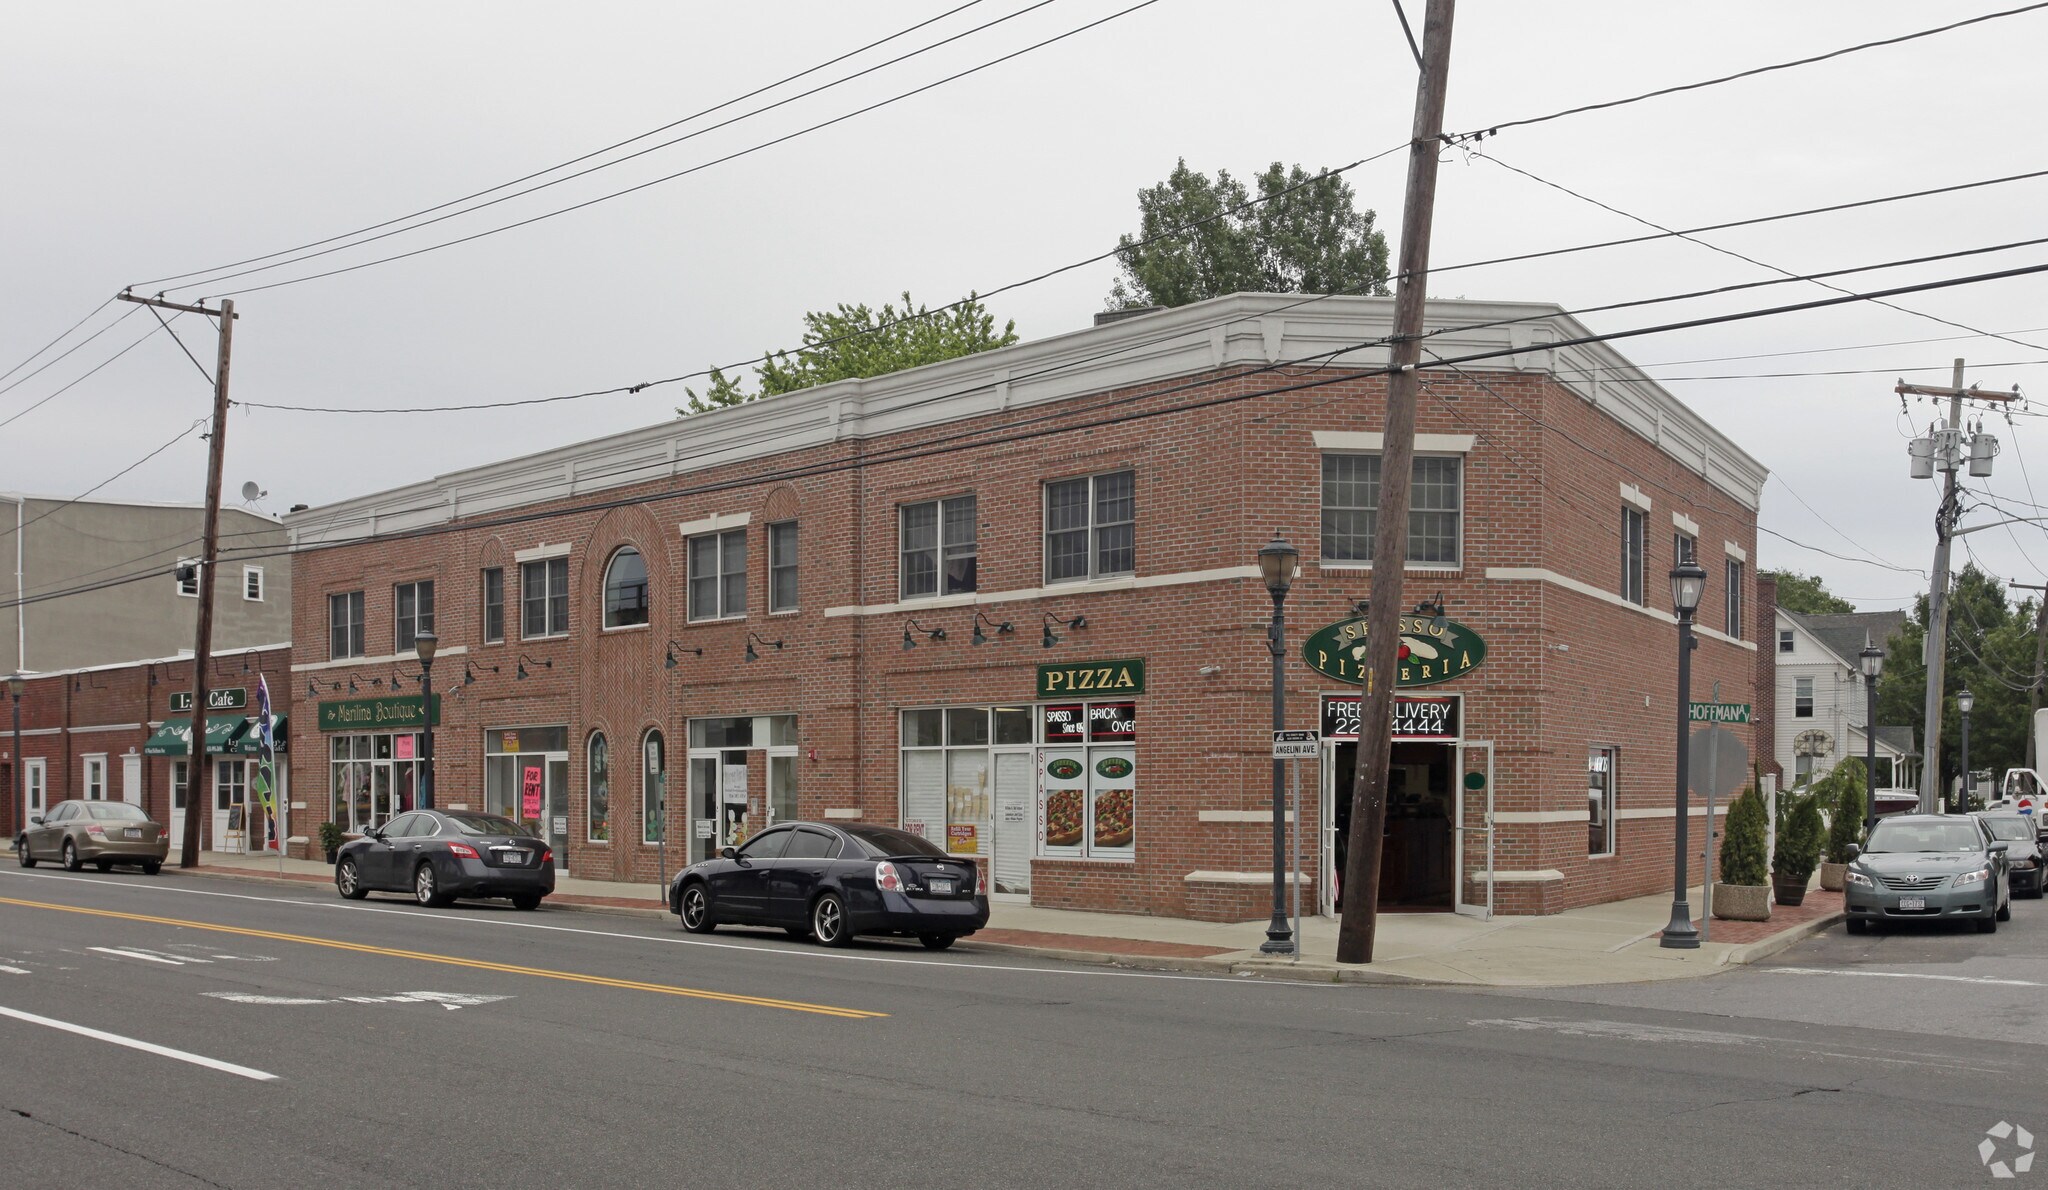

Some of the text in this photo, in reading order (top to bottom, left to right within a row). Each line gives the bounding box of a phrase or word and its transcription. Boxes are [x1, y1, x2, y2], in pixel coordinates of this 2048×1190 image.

[1345, 619, 1444, 640] SPSSO
[1318, 650, 1472, 681] PIZERIA
[1045, 667, 1135, 691] PIZZA
[209, 691, 234, 707] Cafe
[376, 702, 416, 722] Boutique
[1046, 710, 1072, 723] SPASSO
[1090, 707, 1117, 720] BRICK
[1392, 702, 1451, 719] LIVERY
[1689, 704, 1739, 720] HOFFMAN
[1062, 722, 1075, 734] Since
[1275, 745, 1301, 754] ANGELINI
[526, 770, 538, 781] FOR
[524, 783, 540, 797] RENT
